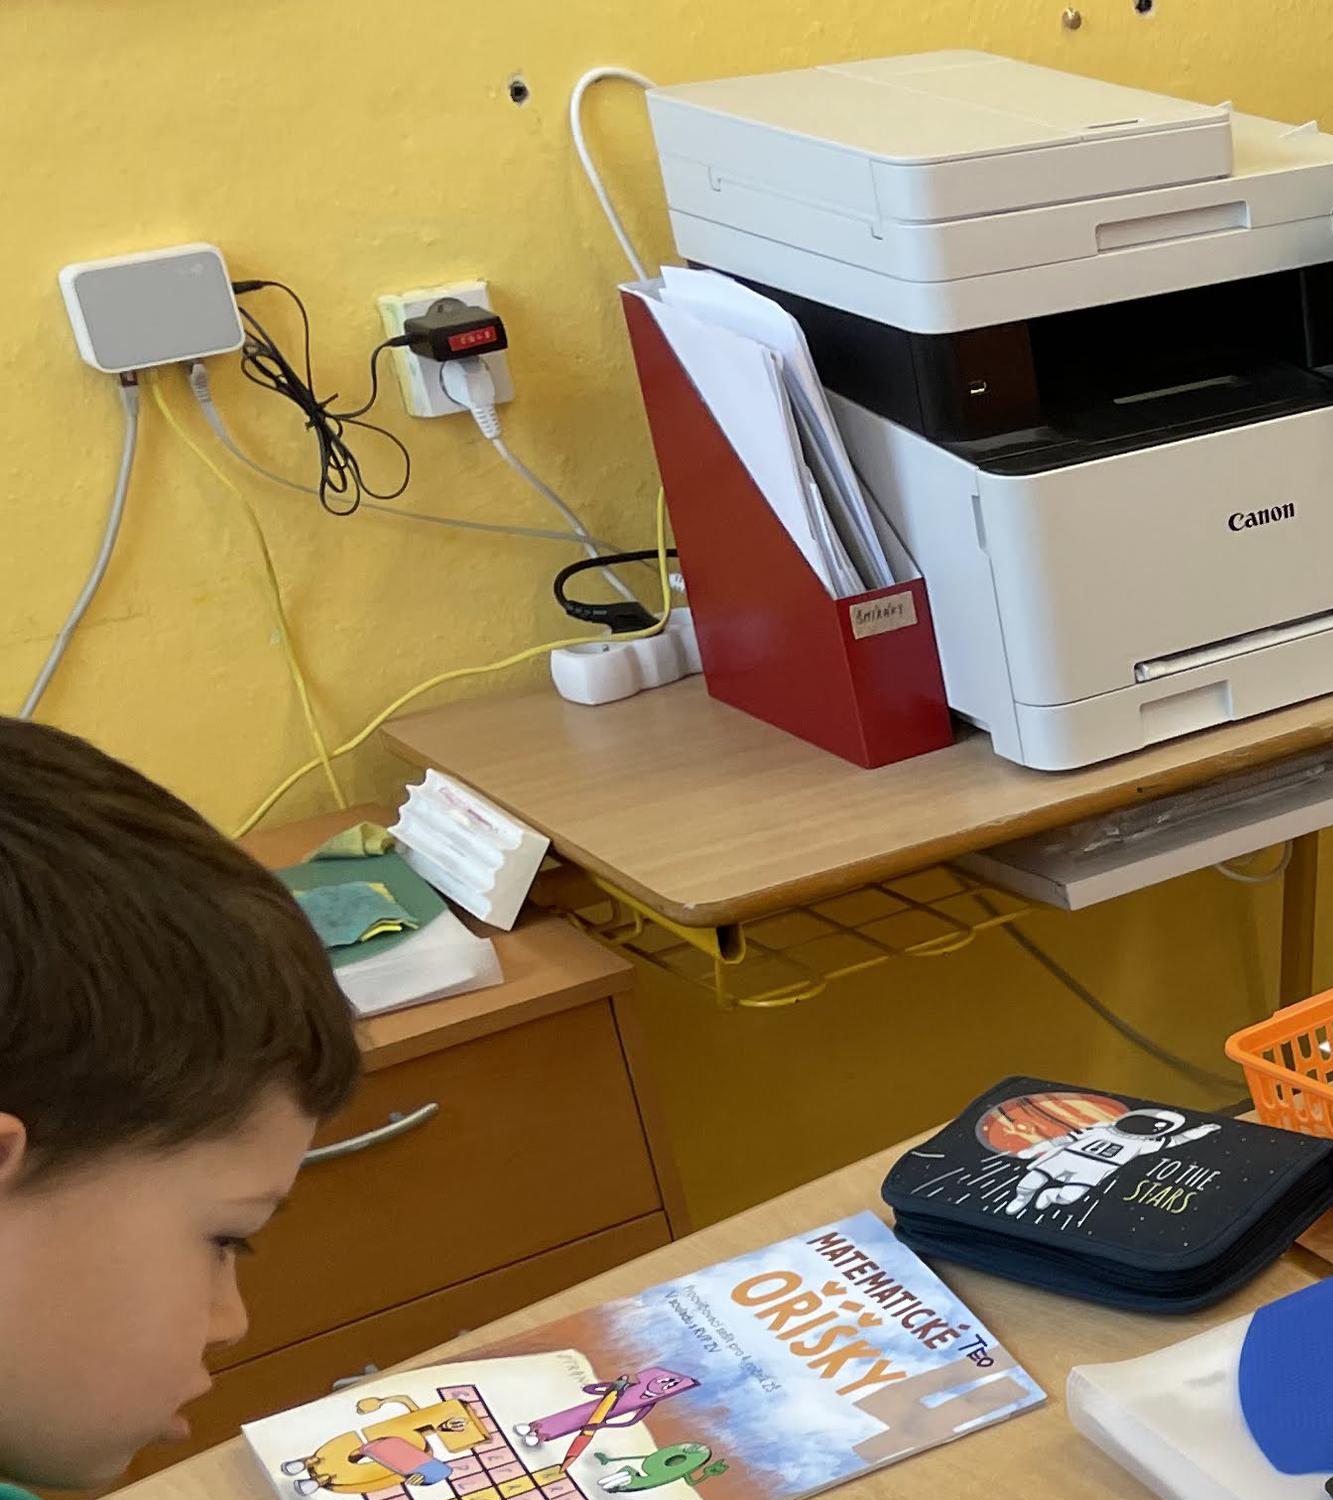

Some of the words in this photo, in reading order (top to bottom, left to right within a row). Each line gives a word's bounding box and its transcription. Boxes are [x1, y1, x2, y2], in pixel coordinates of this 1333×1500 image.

[1228, 501, 1296, 533] Canon
[1146, 1157, 1182, 1181] TO
[1174, 1164, 1221, 1191] THE
[1122, 1179, 1197, 1214] STARS
[806, 1231, 971, 1351] MATEMATICKÉ
[730, 1270, 907, 1397] OŘÍŠKY
[957, 1333, 995, 1369] TEO
